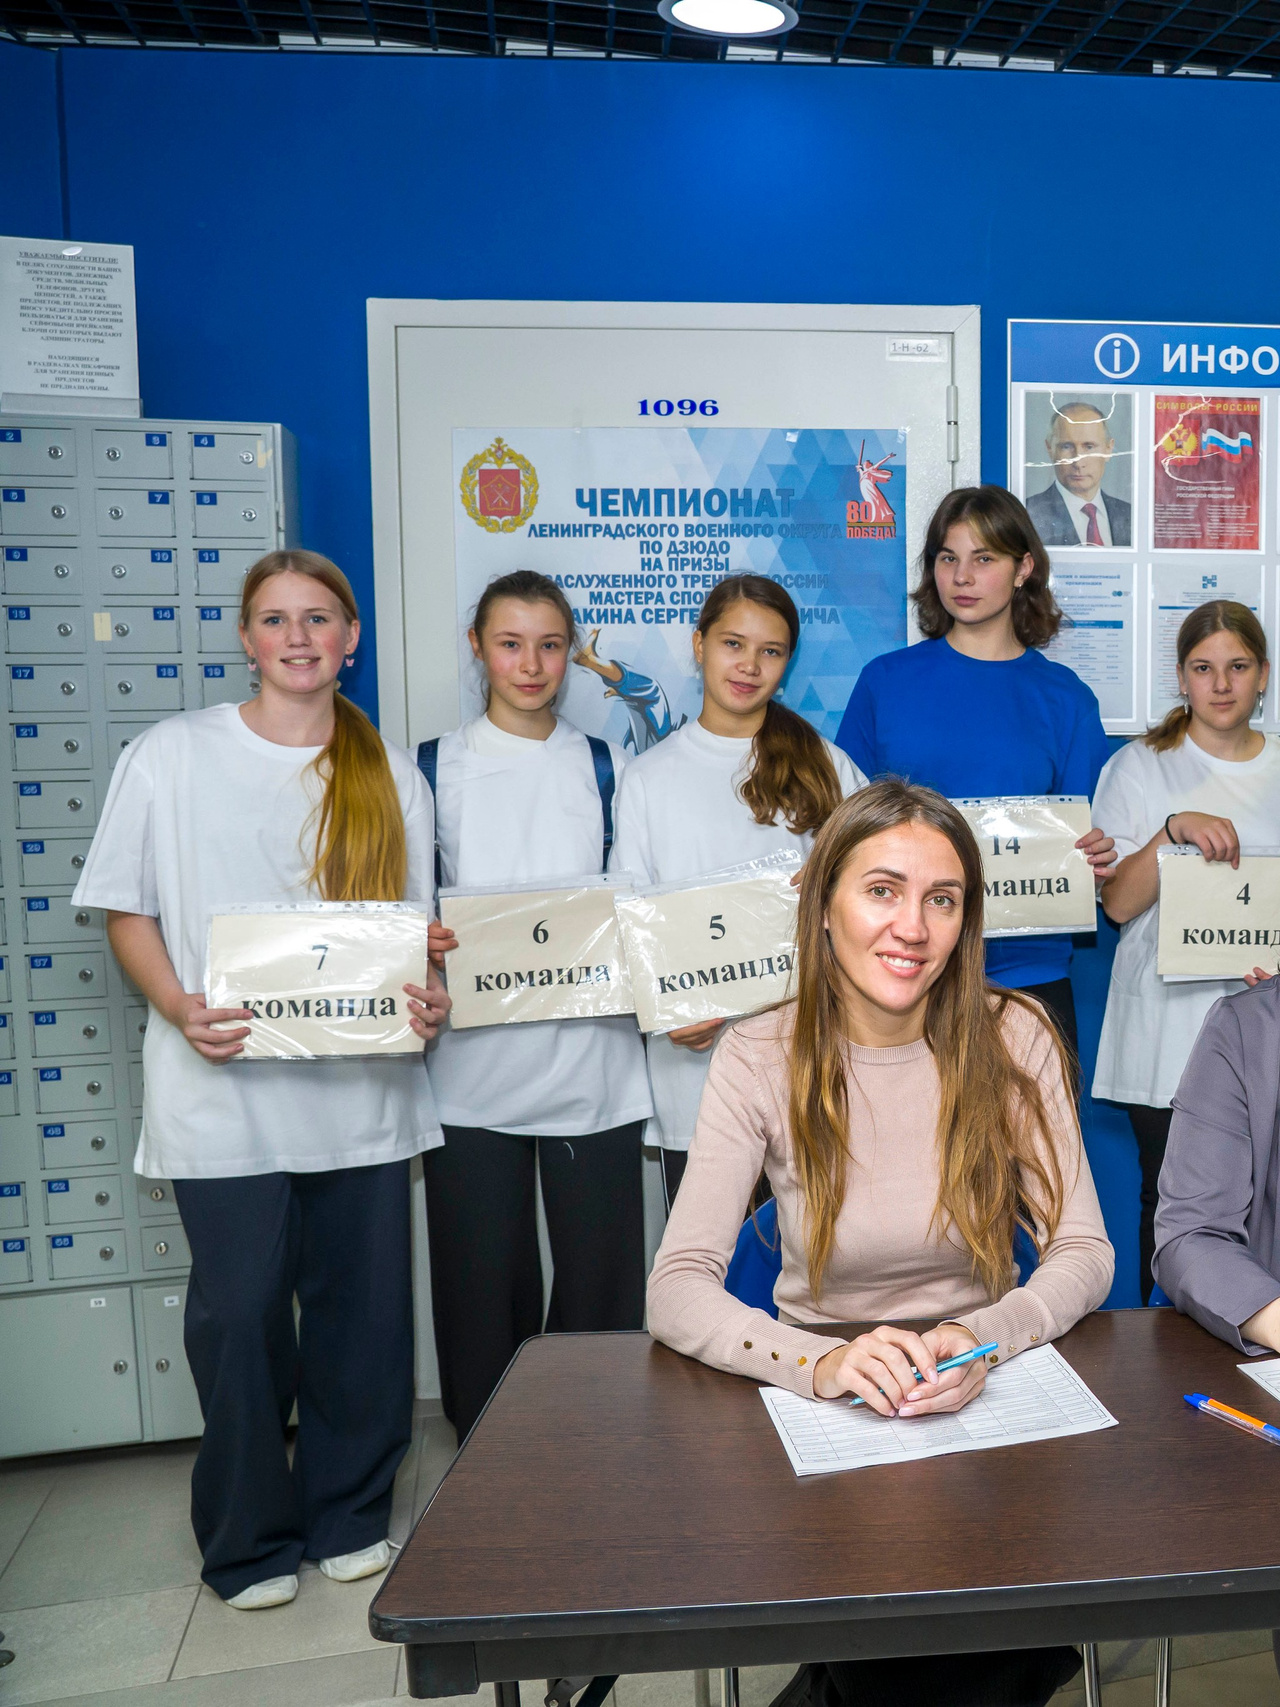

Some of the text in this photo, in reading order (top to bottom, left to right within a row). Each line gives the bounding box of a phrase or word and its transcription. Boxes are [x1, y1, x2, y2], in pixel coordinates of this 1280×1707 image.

[19, 251, 67, 260] УВАЖАЕМЫЕ
[637, 399, 720, 416] 1096
[1156, 402, 1258, 412] СИМВОЛЫ РОССИИ
[575, 488, 795, 517] ЧЕМПИОНАТ
[846, 500, 873, 523] 80
[527, 523, 842, 540] ЛЕНИНГРАДСКОГО ВОЕННОГО ОКРУГА
[846, 527, 896, 540] ПОБЕДА!
[639, 540, 731, 557] ПО ДЗЮДО
[641, 557, 730, 571] НА ПРИЗЫ
[681, 574, 736, 589] ТРЕН
[589, 591, 665, 605] МАСТЕРА
[572, 608, 701, 624] АКИНА СЕРГЕ
[991, 834, 1021, 856] 14
[983, 877, 1071, 898] манда
[1236, 882, 1251, 905] 4
[532, 919, 549, 944] 6
[709, 914, 726, 940] 5
[311, 943, 329, 970] 7
[474, 964, 611, 993] команда
[659, 952, 793, 994] команда
[241, 996, 397, 1020] команда
